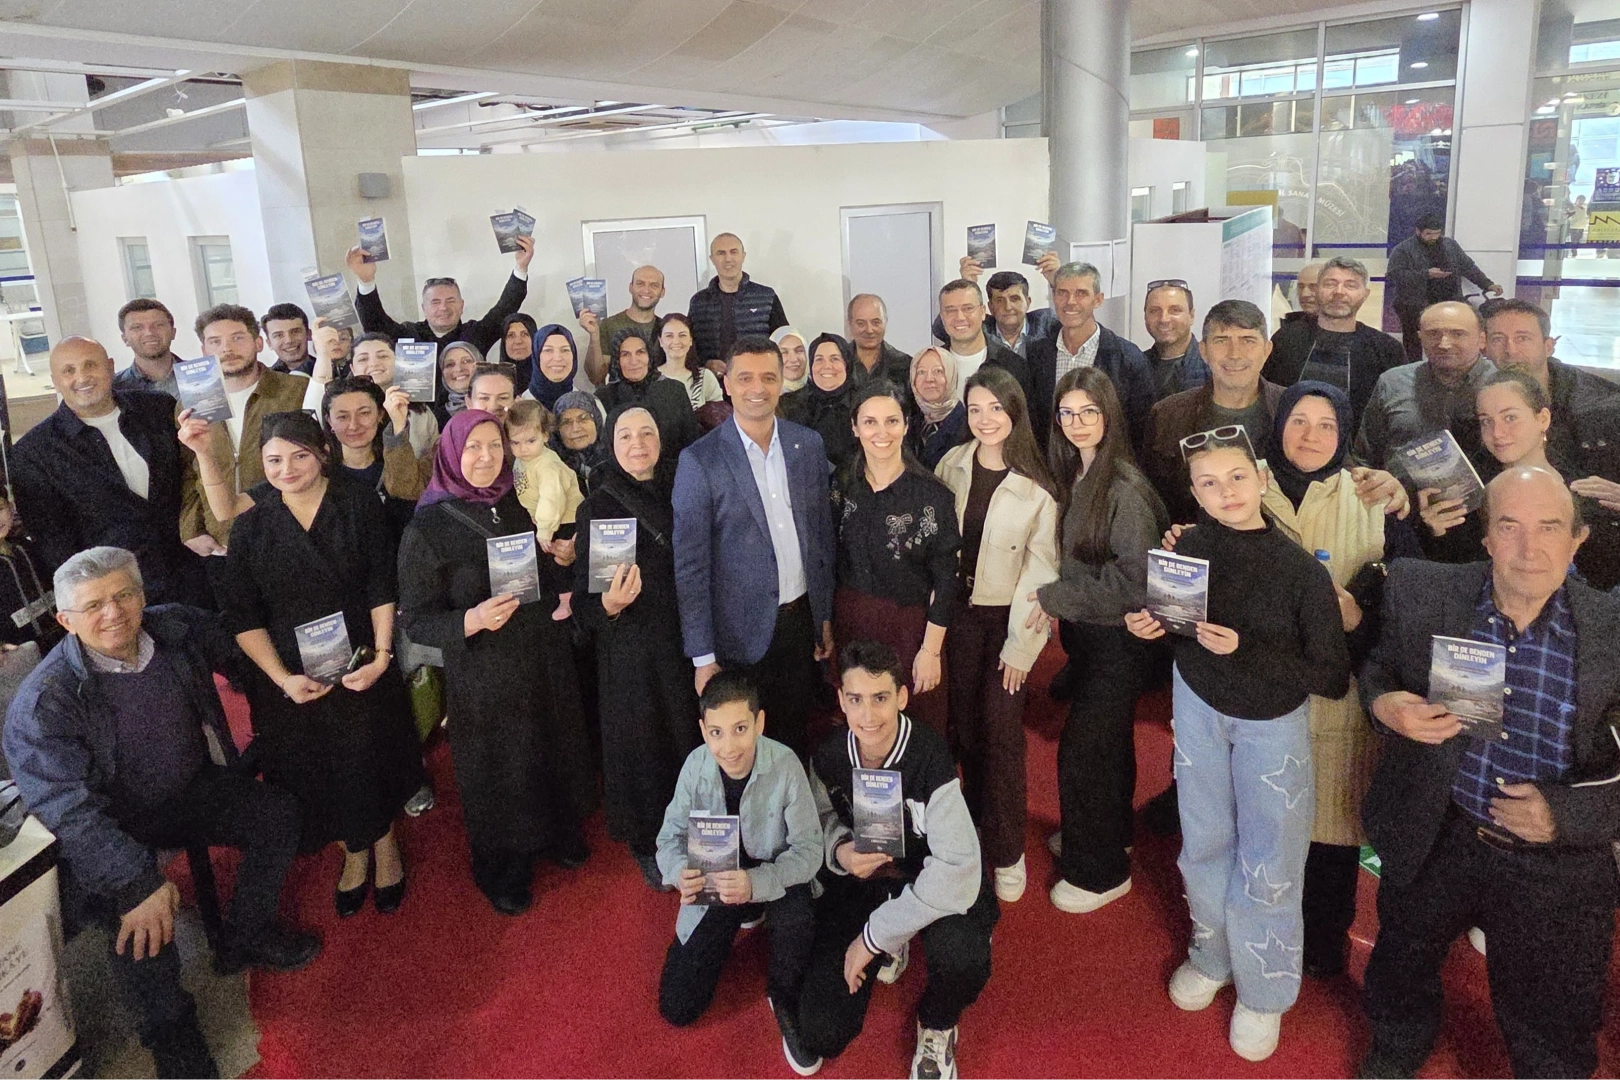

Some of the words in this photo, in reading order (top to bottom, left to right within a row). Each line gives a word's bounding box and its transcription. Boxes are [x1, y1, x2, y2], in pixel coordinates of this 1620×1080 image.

[1287, 190, 1310, 199] SANA
[1448, 644, 1459, 652] BİR
[1469, 648, 1495, 659] BENDEN
